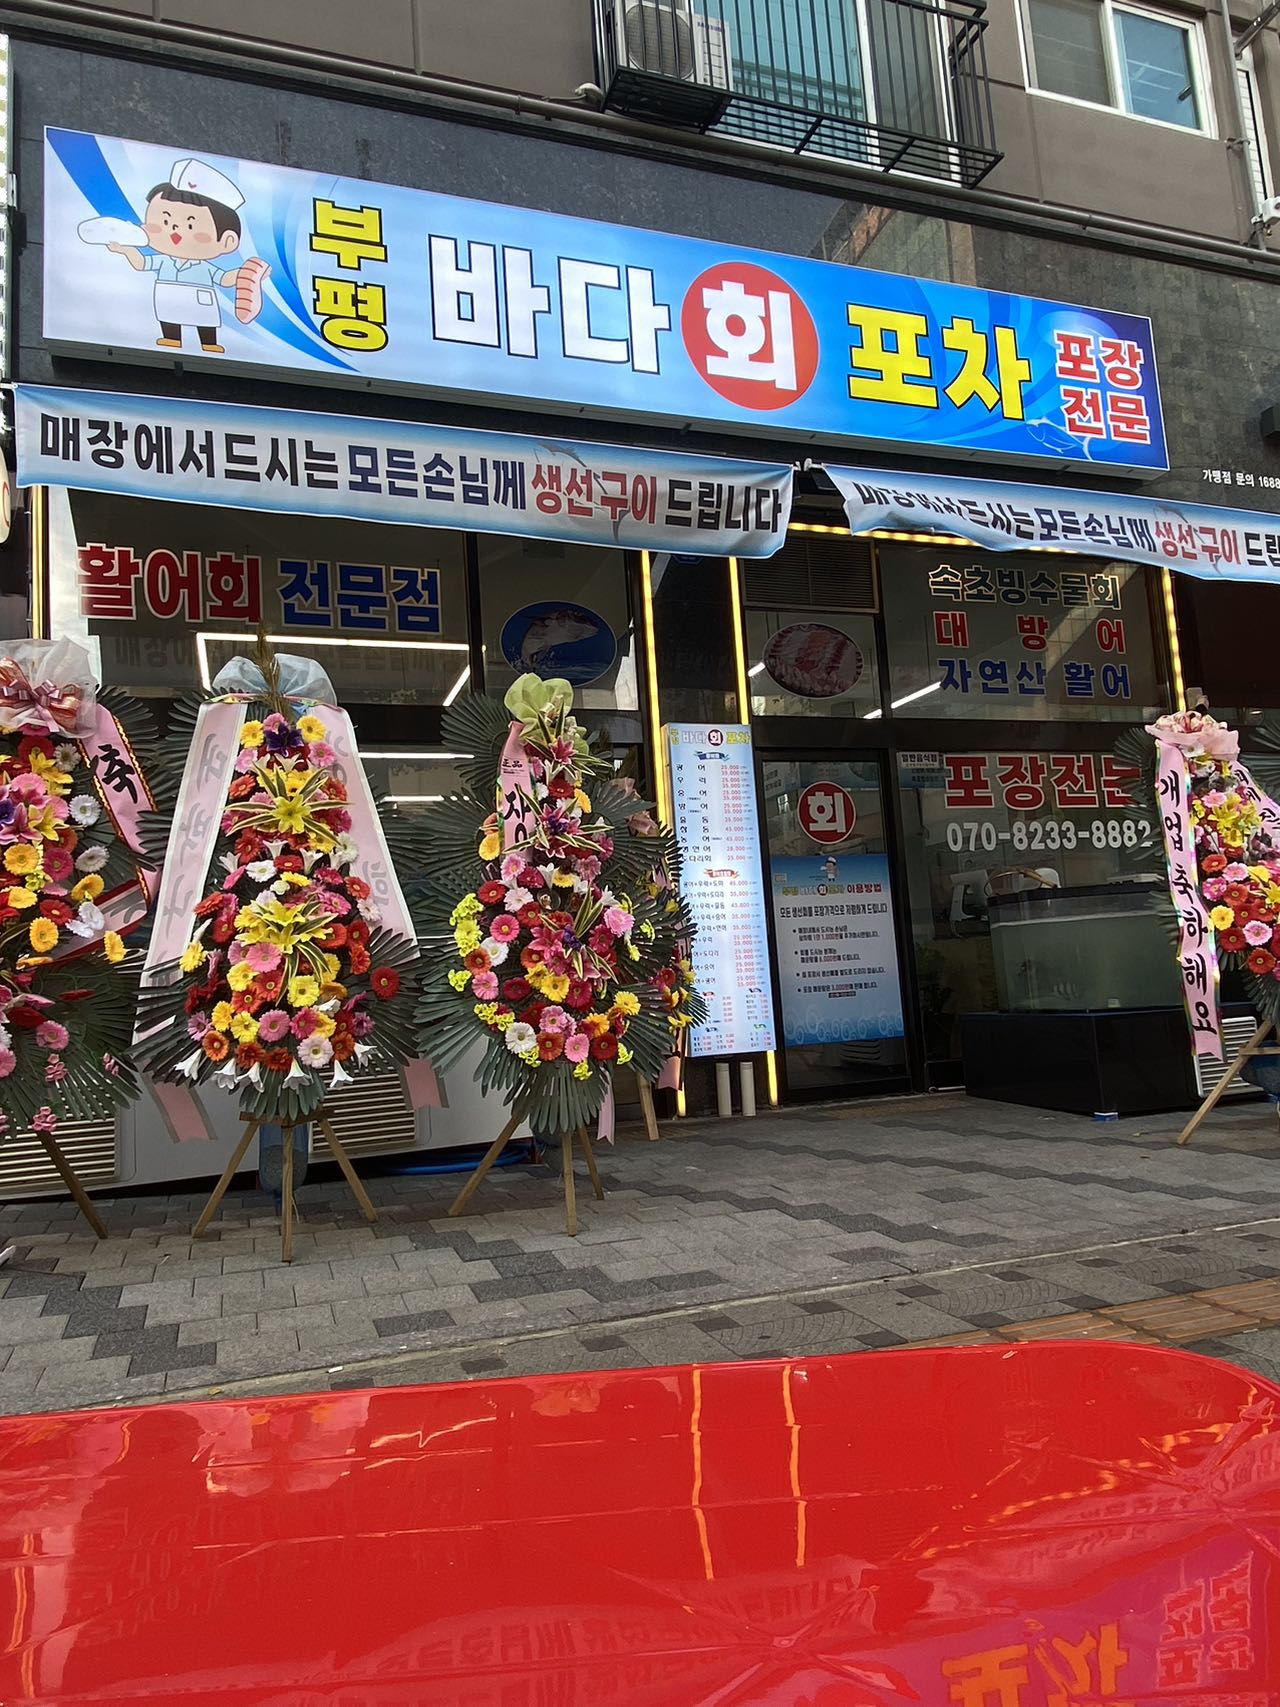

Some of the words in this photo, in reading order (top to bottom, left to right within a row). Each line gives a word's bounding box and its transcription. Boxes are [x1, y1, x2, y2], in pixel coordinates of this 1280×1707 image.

[310, 197, 389, 352] 부평
[428, 234, 671, 374] 바다
[701, 280, 799, 391] 회
[847, 303, 1031, 420] 포차
[1055, 328, 1144, 390] 포장
[1062, 385, 1151, 445] 전문
[664, 478, 782, 534] 드립니다
[1202, 468, 1232, 486] 가맹점
[1235, 471, 1255, 488] 문의
[77, 541, 262, 625] 활어회
[276, 556, 442, 635] 전문점
[928, 563, 1121, 610] 속초빙수물회
[940, 657, 1047, 697] 자연산
[1063, 661, 1131, 699] 활어
[806, 789, 848, 836] 회
[946, 819, 1153, 852] 070-8233-8882
